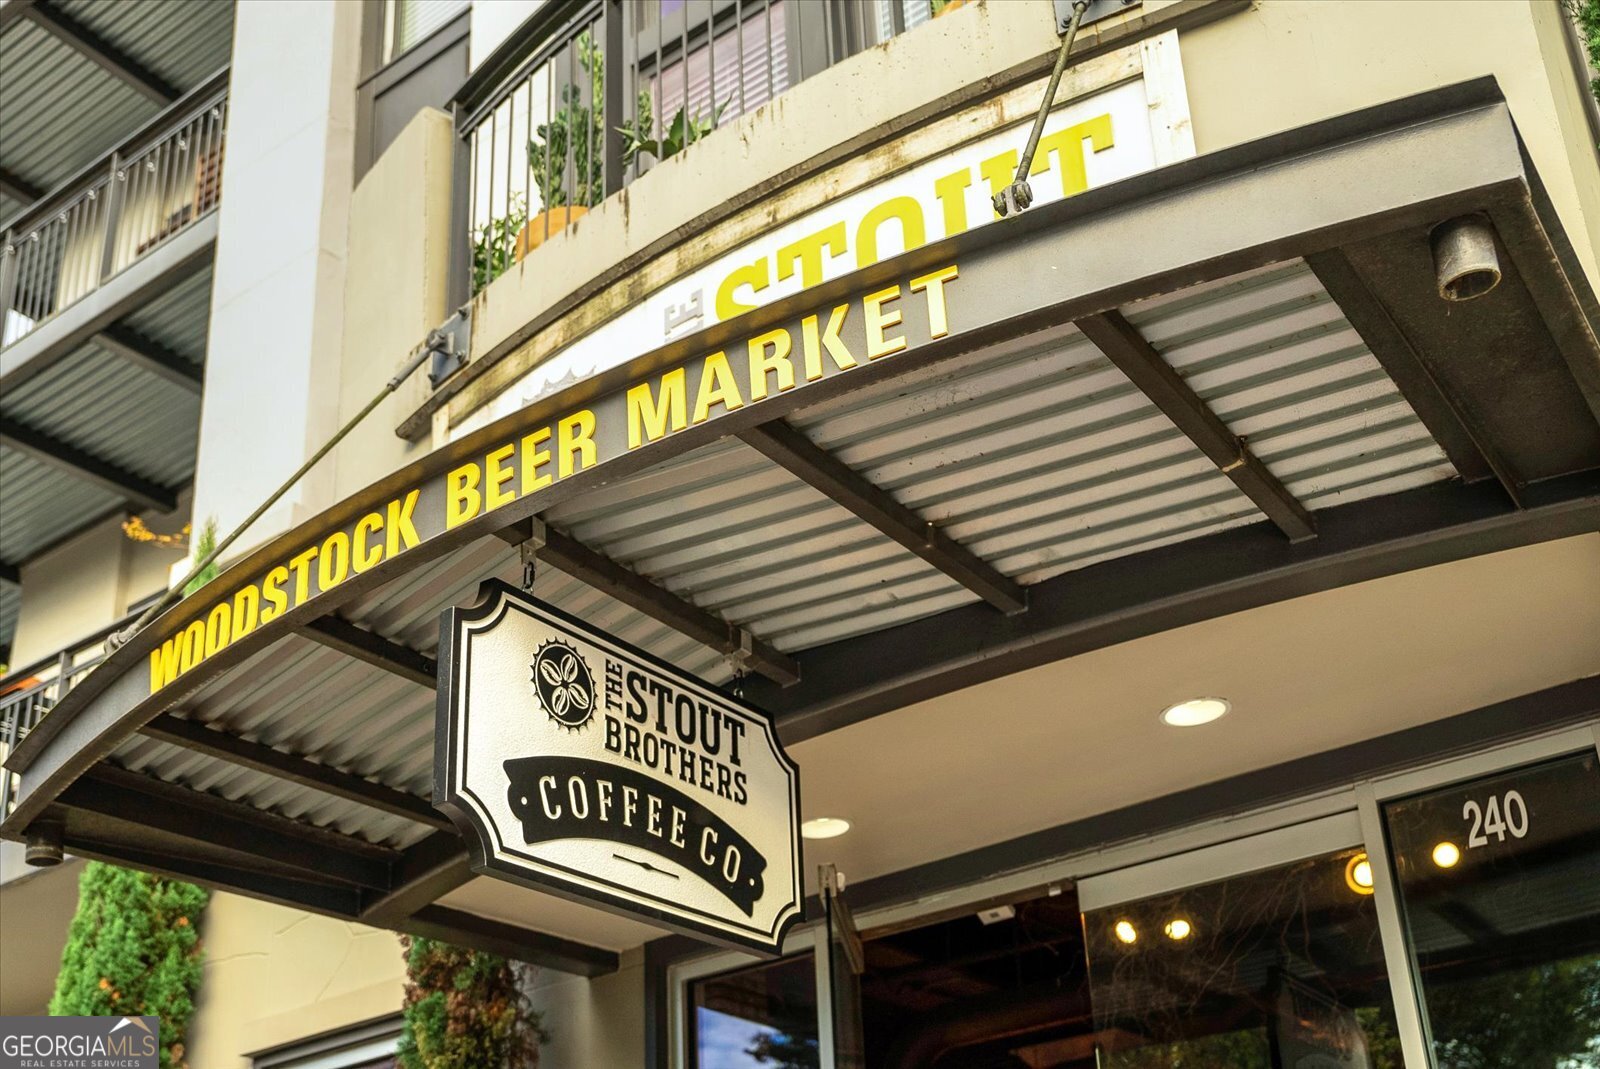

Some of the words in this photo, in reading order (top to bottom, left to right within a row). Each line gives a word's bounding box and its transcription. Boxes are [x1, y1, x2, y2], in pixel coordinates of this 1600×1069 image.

[150, 489, 420, 696] WOODSTOCK
[447, 409, 598, 531] BEER
[627, 264, 959, 451] MARKET
[605, 658, 623, 711] THE
[626, 670, 745, 767] STOUT
[604, 714, 748, 805] BROTHERS
[539, 775, 687, 849] COFFEE
[699, 826, 742, 884] CO
[1463, 789, 1529, 849] 240
